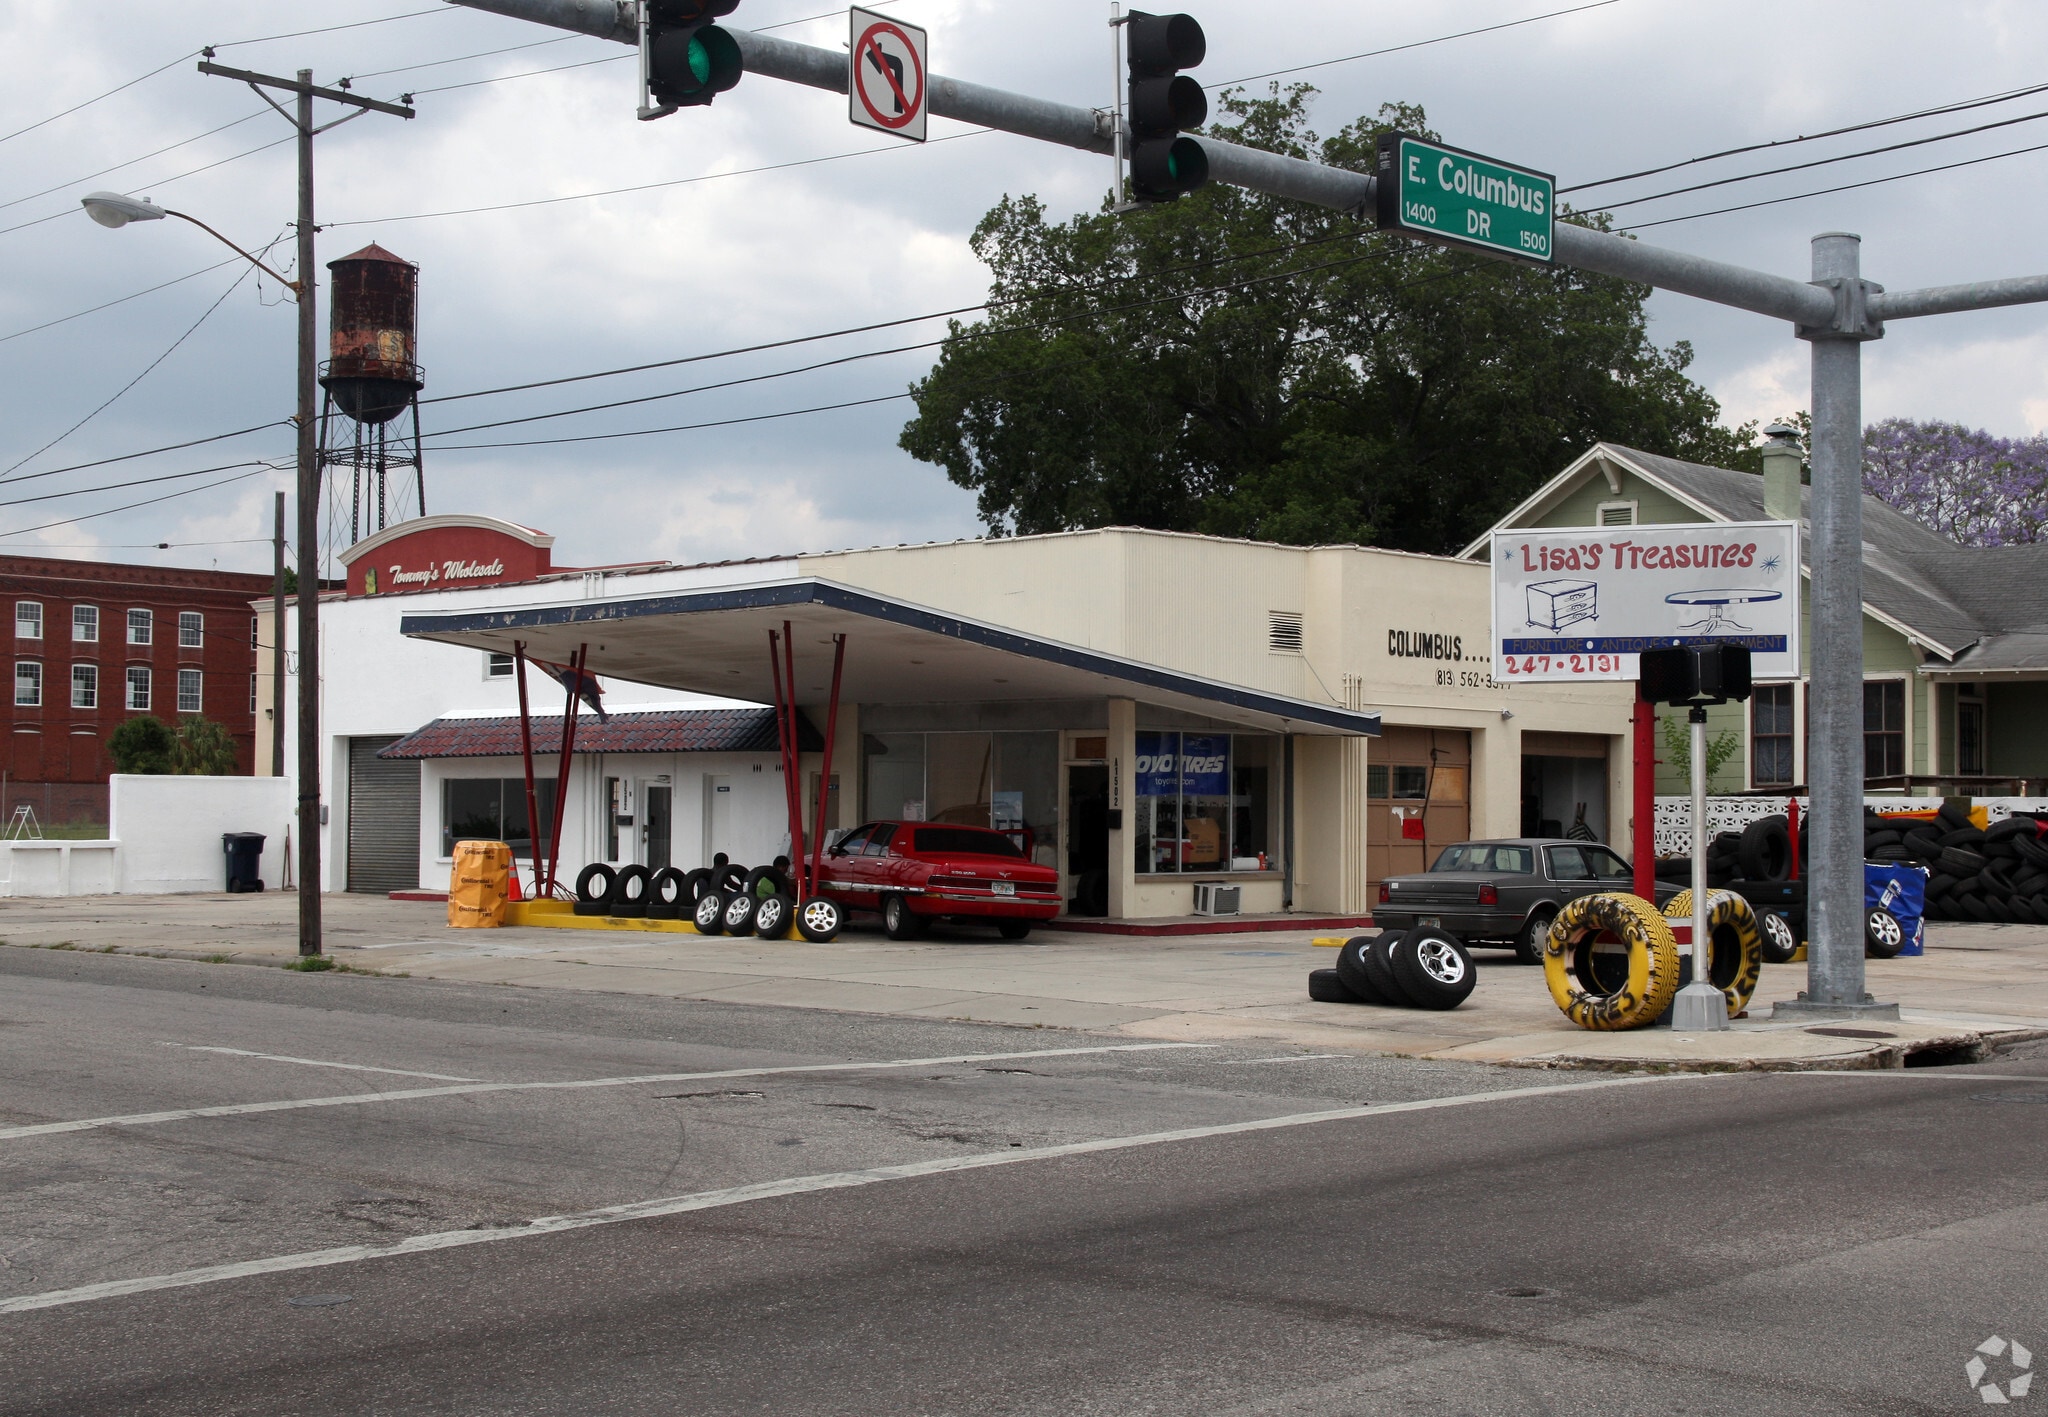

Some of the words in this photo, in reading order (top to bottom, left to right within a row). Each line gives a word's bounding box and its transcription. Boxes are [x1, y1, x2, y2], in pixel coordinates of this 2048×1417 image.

[1408, 155, 1427, 185] E.
[1438, 156, 1545, 216] Columbus
[1405, 201, 1436, 225] 1400
[1467, 208, 1491, 239] DR
[1519, 230, 1547, 252] 1500
[1609, 540, 1757, 570] Treasures
[389, 562, 440, 587] Tommy's
[443, 558, 504, 580] Wholesale
[1513, 638, 1584, 652] FURNITURE
[1600, 637, 1670, 652] ANTIQUES
[1135, 754, 1173, 773] OYO
